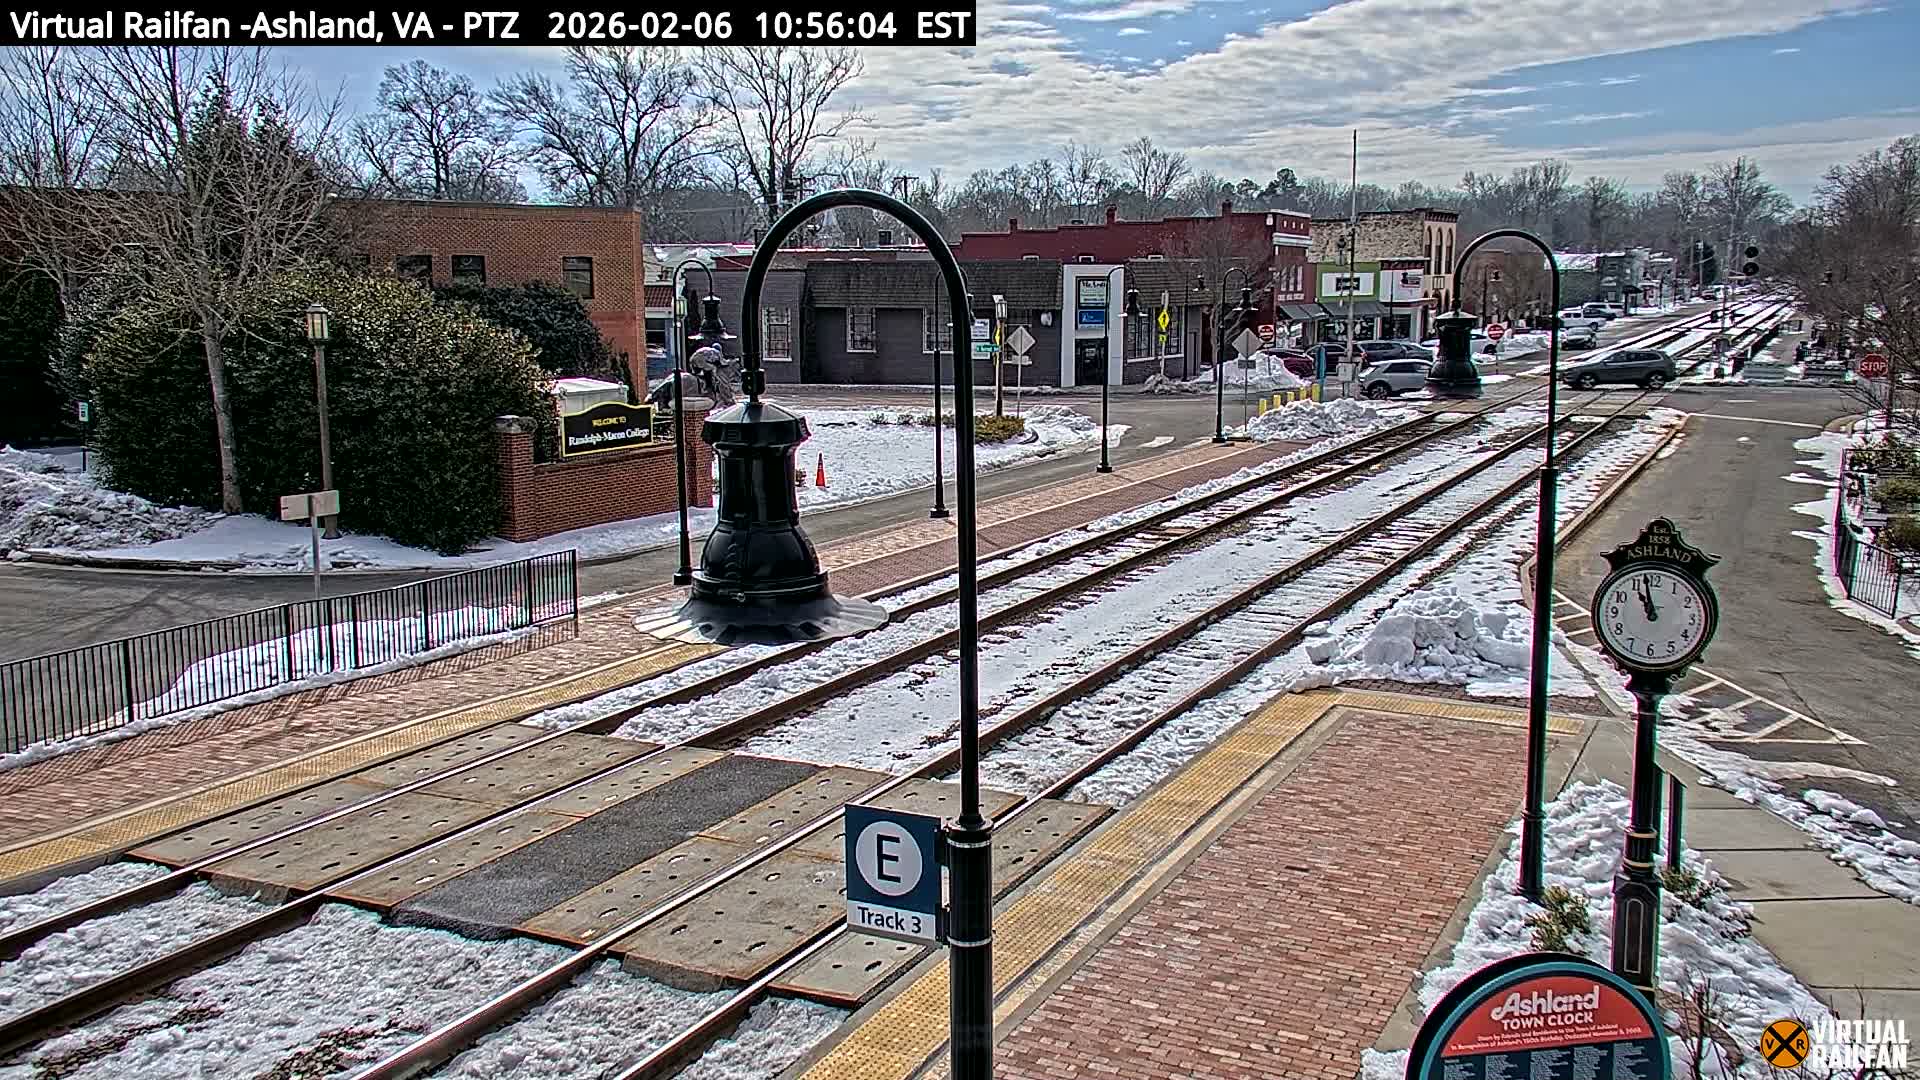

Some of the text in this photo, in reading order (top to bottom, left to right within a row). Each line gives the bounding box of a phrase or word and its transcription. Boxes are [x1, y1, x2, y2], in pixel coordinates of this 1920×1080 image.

[1861, 361, 1886, 372] STOP
[626, 428, 650, 438] College
[1649, 536, 1671, 544] 1858
[1626, 546, 1692, 564] ASHLAND
[1632, 578, 1640, 592] 11
[1650, 576, 1662, 588] 12
[1616, 591, 1628, 604] 10
[1684, 596, 1692, 608] 2
[1610, 606, 1618, 618] 9
[1688, 614, 1696, 626] 3
[1614, 623, 1623, 636] 8
[1681, 630, 1690, 642] 4
[1628, 638, 1636, 651] 7
[1647, 644, 1654, 656] 6
[1667, 641, 1676, 654] 5
[876, 834, 902, 884] E
[857, 906, 922, 934] Track 3
[1491, 985, 1600, 1021] Ashland
[1502, 1010, 1594, 1032] TOWN CLOCK
